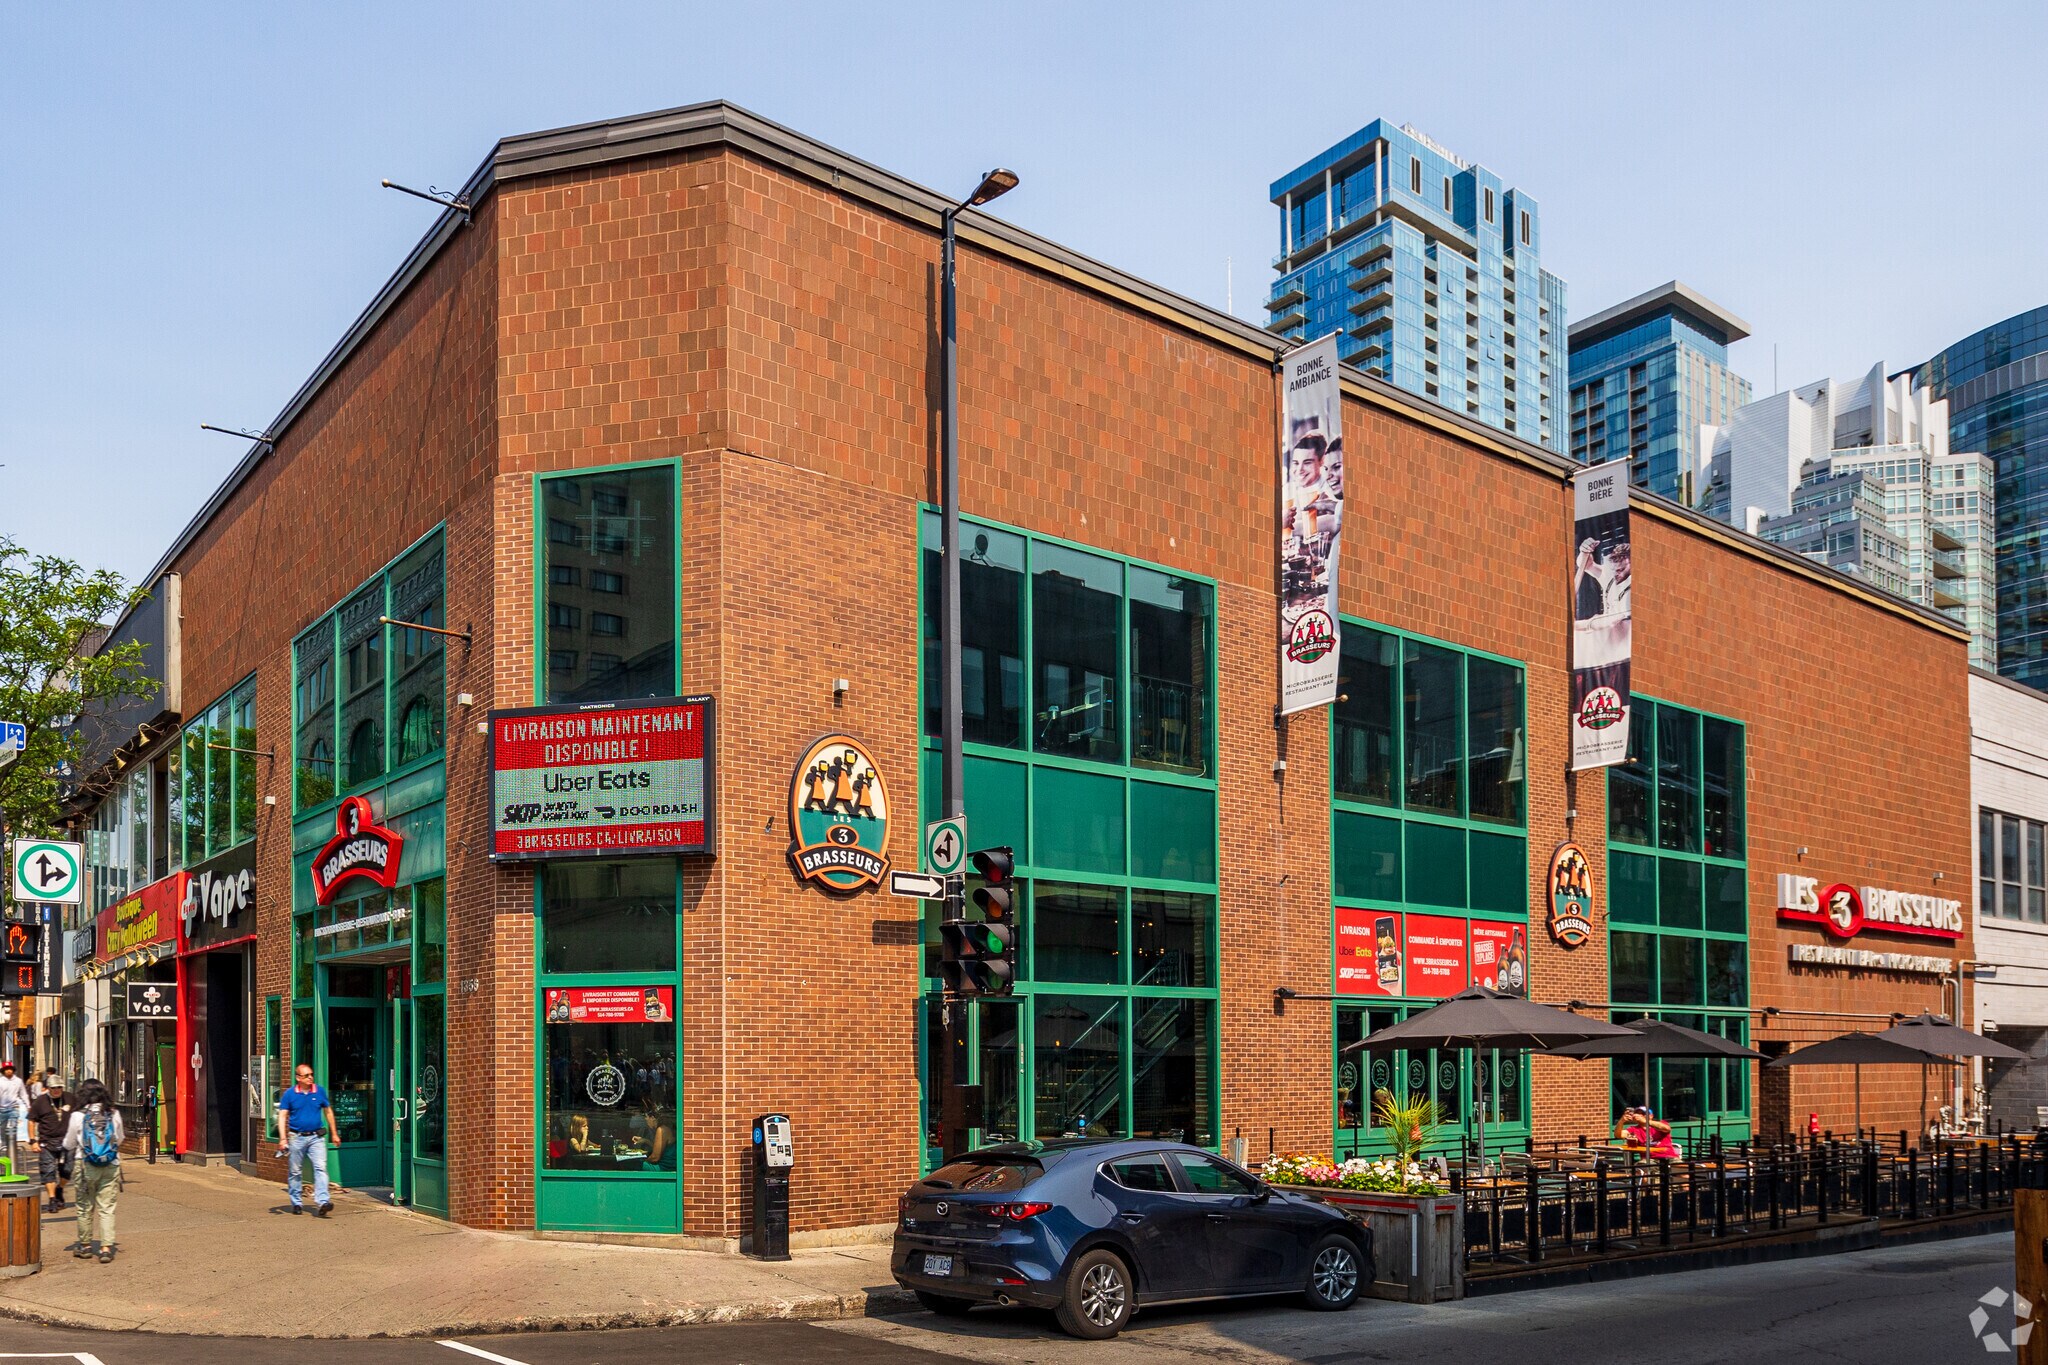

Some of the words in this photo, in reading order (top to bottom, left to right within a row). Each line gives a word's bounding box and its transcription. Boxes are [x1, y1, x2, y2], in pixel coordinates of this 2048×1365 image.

[1297, 355, 1323, 376] BONNE
[1289, 366, 1332, 392] AMBIANCE
[1588, 476, 1614, 491] BONNE
[1590, 487, 1613, 502] BIÈRE
[1309, 636, 1315, 644] 3
[1291, 641, 1331, 658] BRASSEURS
[1286, 673, 1333, 689] MICROBRASSERIE
[1285, 683, 1320, 696] RESTAURANT
[503, 718, 586, 742] LIVRAISON
[591, 711, 694, 737] MAINTENANT
[1582, 713, 1620, 724] BRASSEURS
[545, 739, 639, 763] DISPONIBLE
[1576, 747, 1610, 756] RESTAURANT
[1577, 740, 1623, 750] MICROBRASSERIE
[543, 773, 594, 793] Uber
[599, 769, 651, 790] Eats
[502, 803, 541, 824] SKIP
[619, 803, 697, 817] DOORDASH
[349, 807, 359, 835] 3
[833, 815, 852, 823] LES
[838, 829, 849, 843] 3
[322, 839, 389, 887] BRASSEURS
[803, 849, 882, 875] BRASSEURS
[200, 868, 250, 928] Vape
[1778, 873, 1820, 913] LES
[1830, 891, 1852, 928] 3
[1860, 886, 1963, 932] BRASSEURS
[1571, 904, 1578, 915] 3
[120, 910, 158, 949] Halloween
[1340, 925, 1371, 936] LIVRAISON
[1555, 919, 1590, 935] BRASSEURS
[1408, 936, 1435, 945] COMMANDE
[1440, 938, 1463, 947] EMPORTER
[1339, 946, 1355, 956] Uber
[1355, 946, 1373, 958] Eats
[1792, 944, 1855, 966] RESTAURANT
[132, 1002, 172, 1015] Vape
